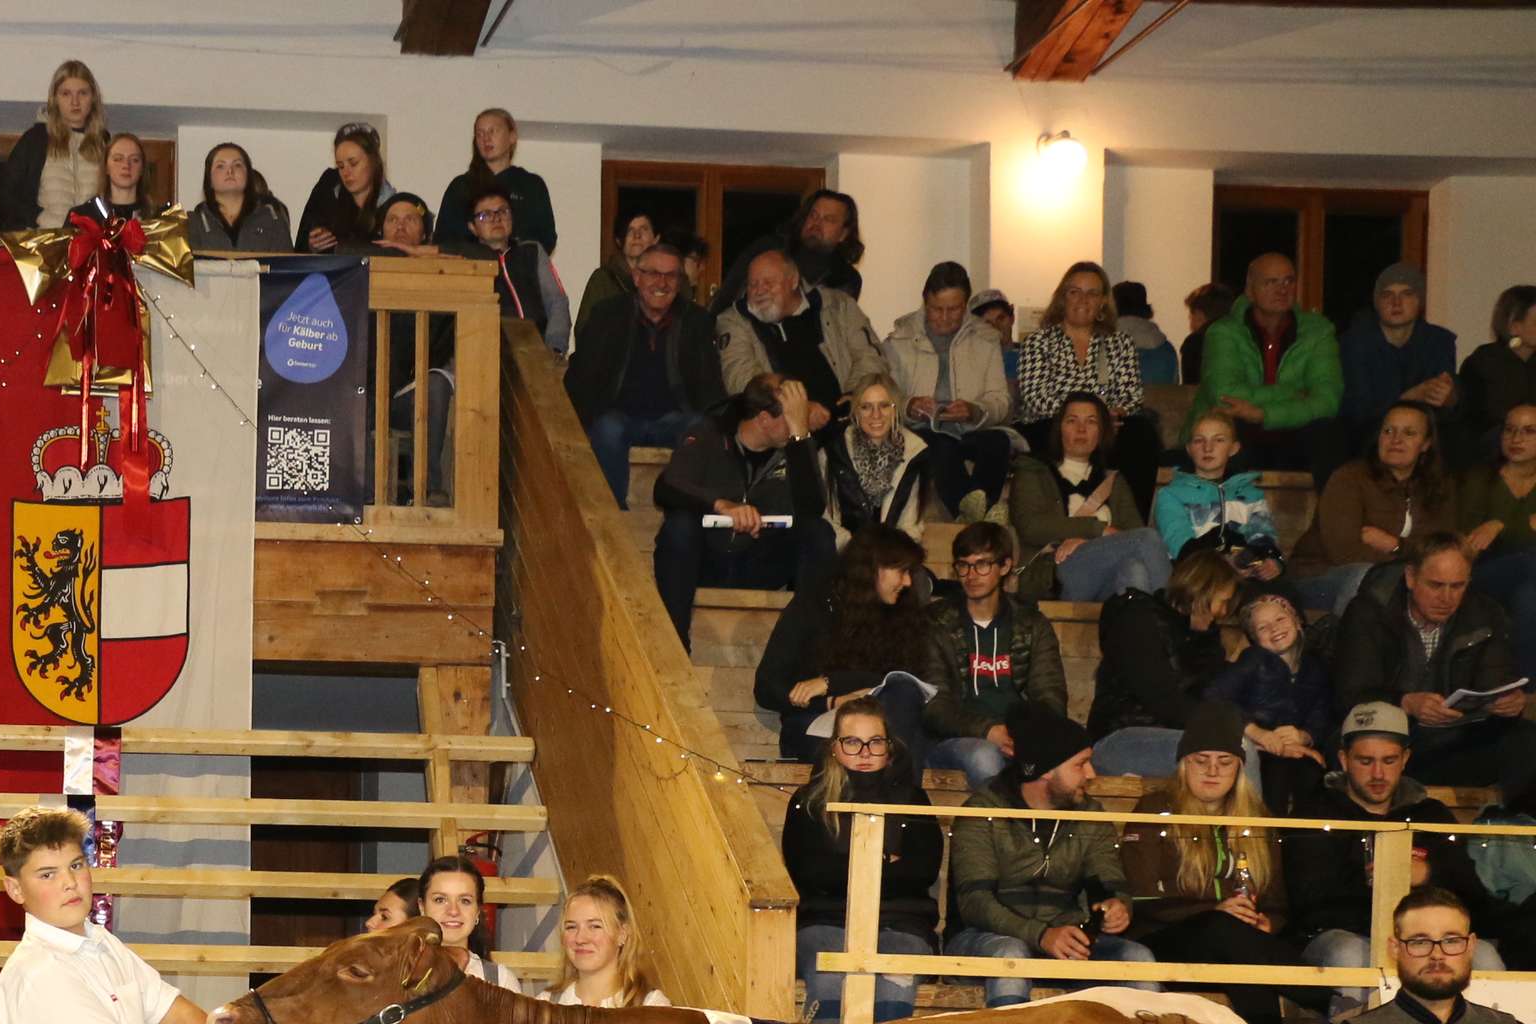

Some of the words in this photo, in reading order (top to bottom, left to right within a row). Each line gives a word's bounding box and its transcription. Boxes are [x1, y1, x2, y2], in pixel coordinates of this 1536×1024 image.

[288, 311, 310, 325] Jetzt
[311, 318, 334, 329] auch
[278, 322, 292, 333] für
[293, 325, 325, 340] Kälber
[326, 332, 338, 342] ab
[288, 337, 323, 351] Geburt
